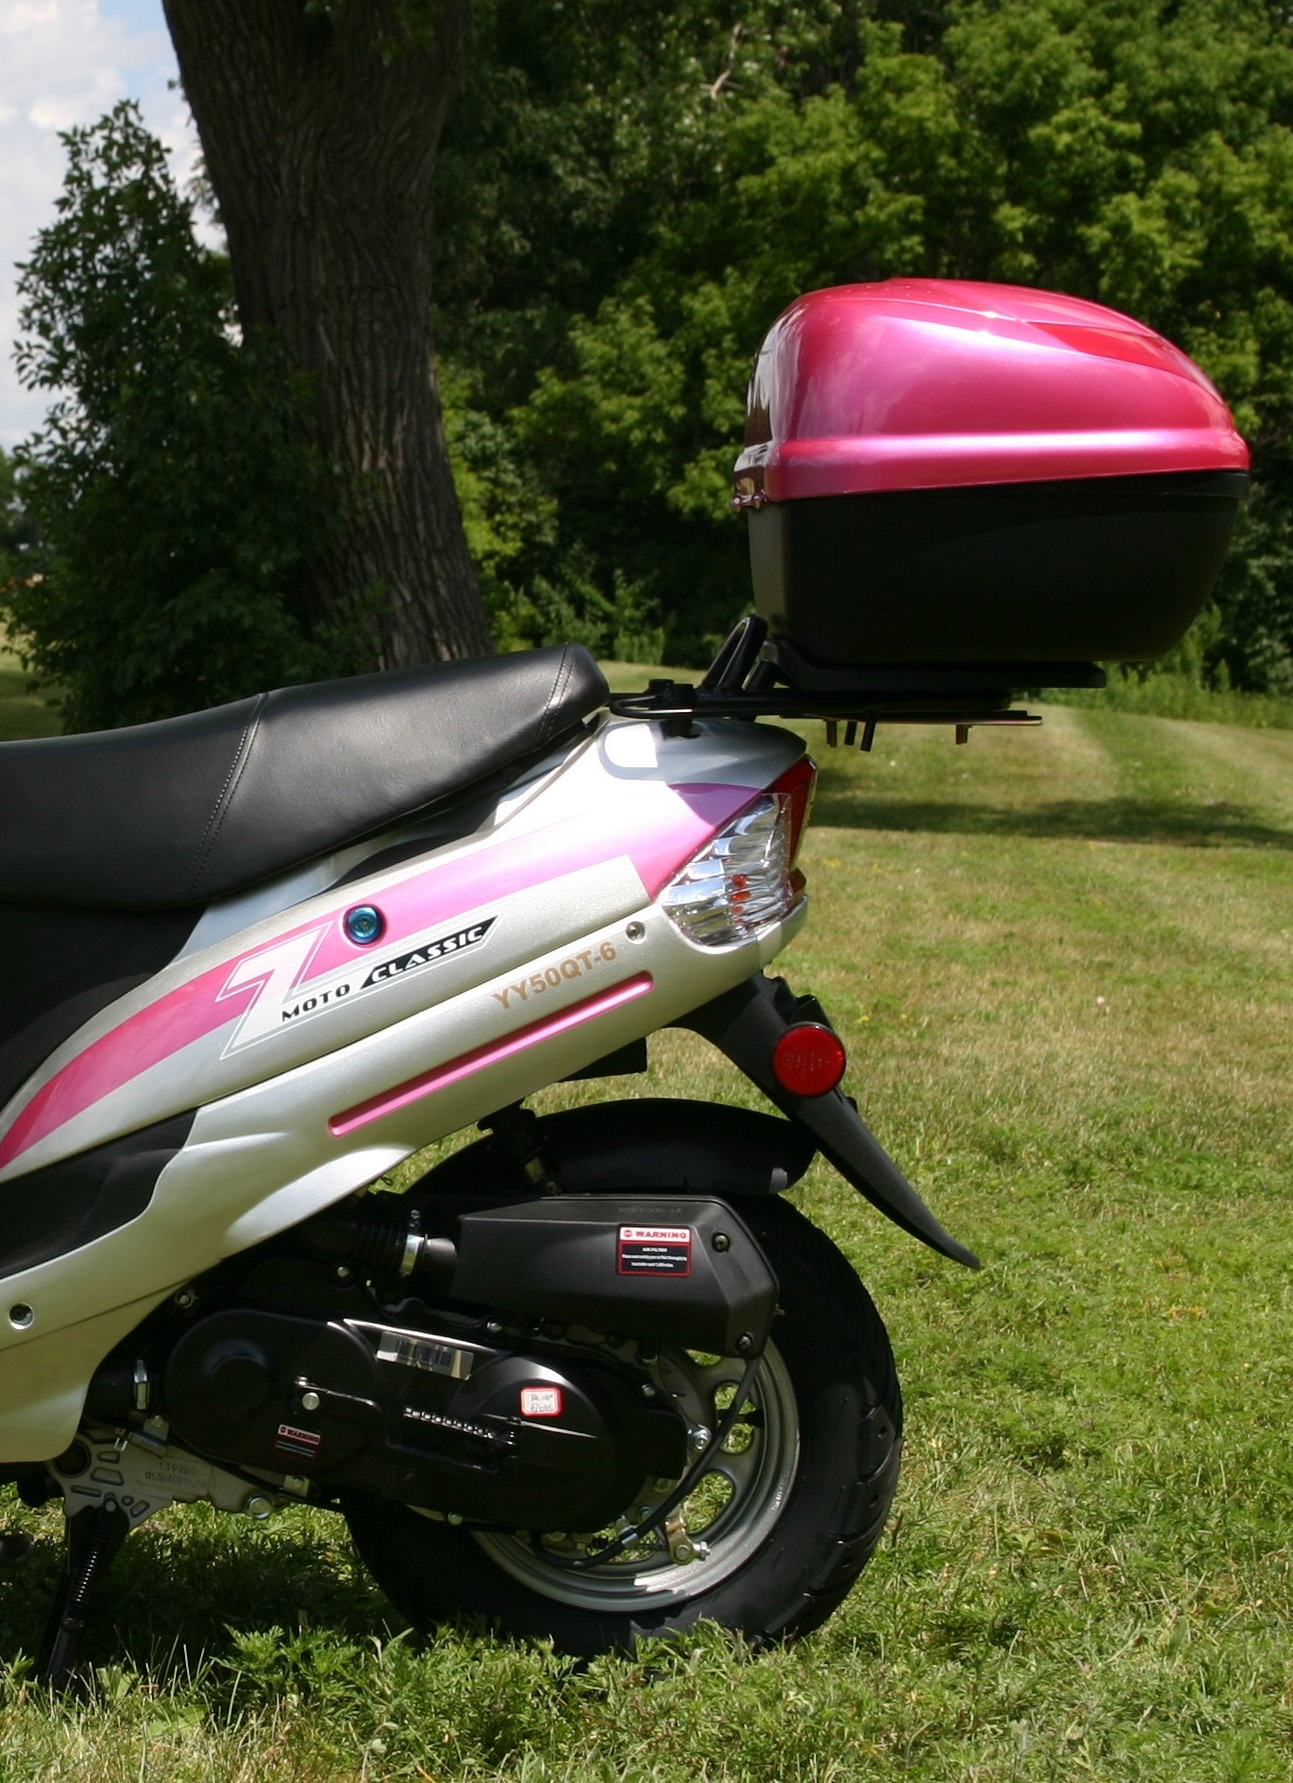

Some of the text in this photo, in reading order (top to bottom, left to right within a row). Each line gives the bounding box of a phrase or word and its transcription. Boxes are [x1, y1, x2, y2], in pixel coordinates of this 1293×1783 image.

[281, 926, 484, 1022] MOTO CLASSIC
[491, 941, 617, 1009] YY50QT-6
[635, 1230, 687, 1240] WARNING
